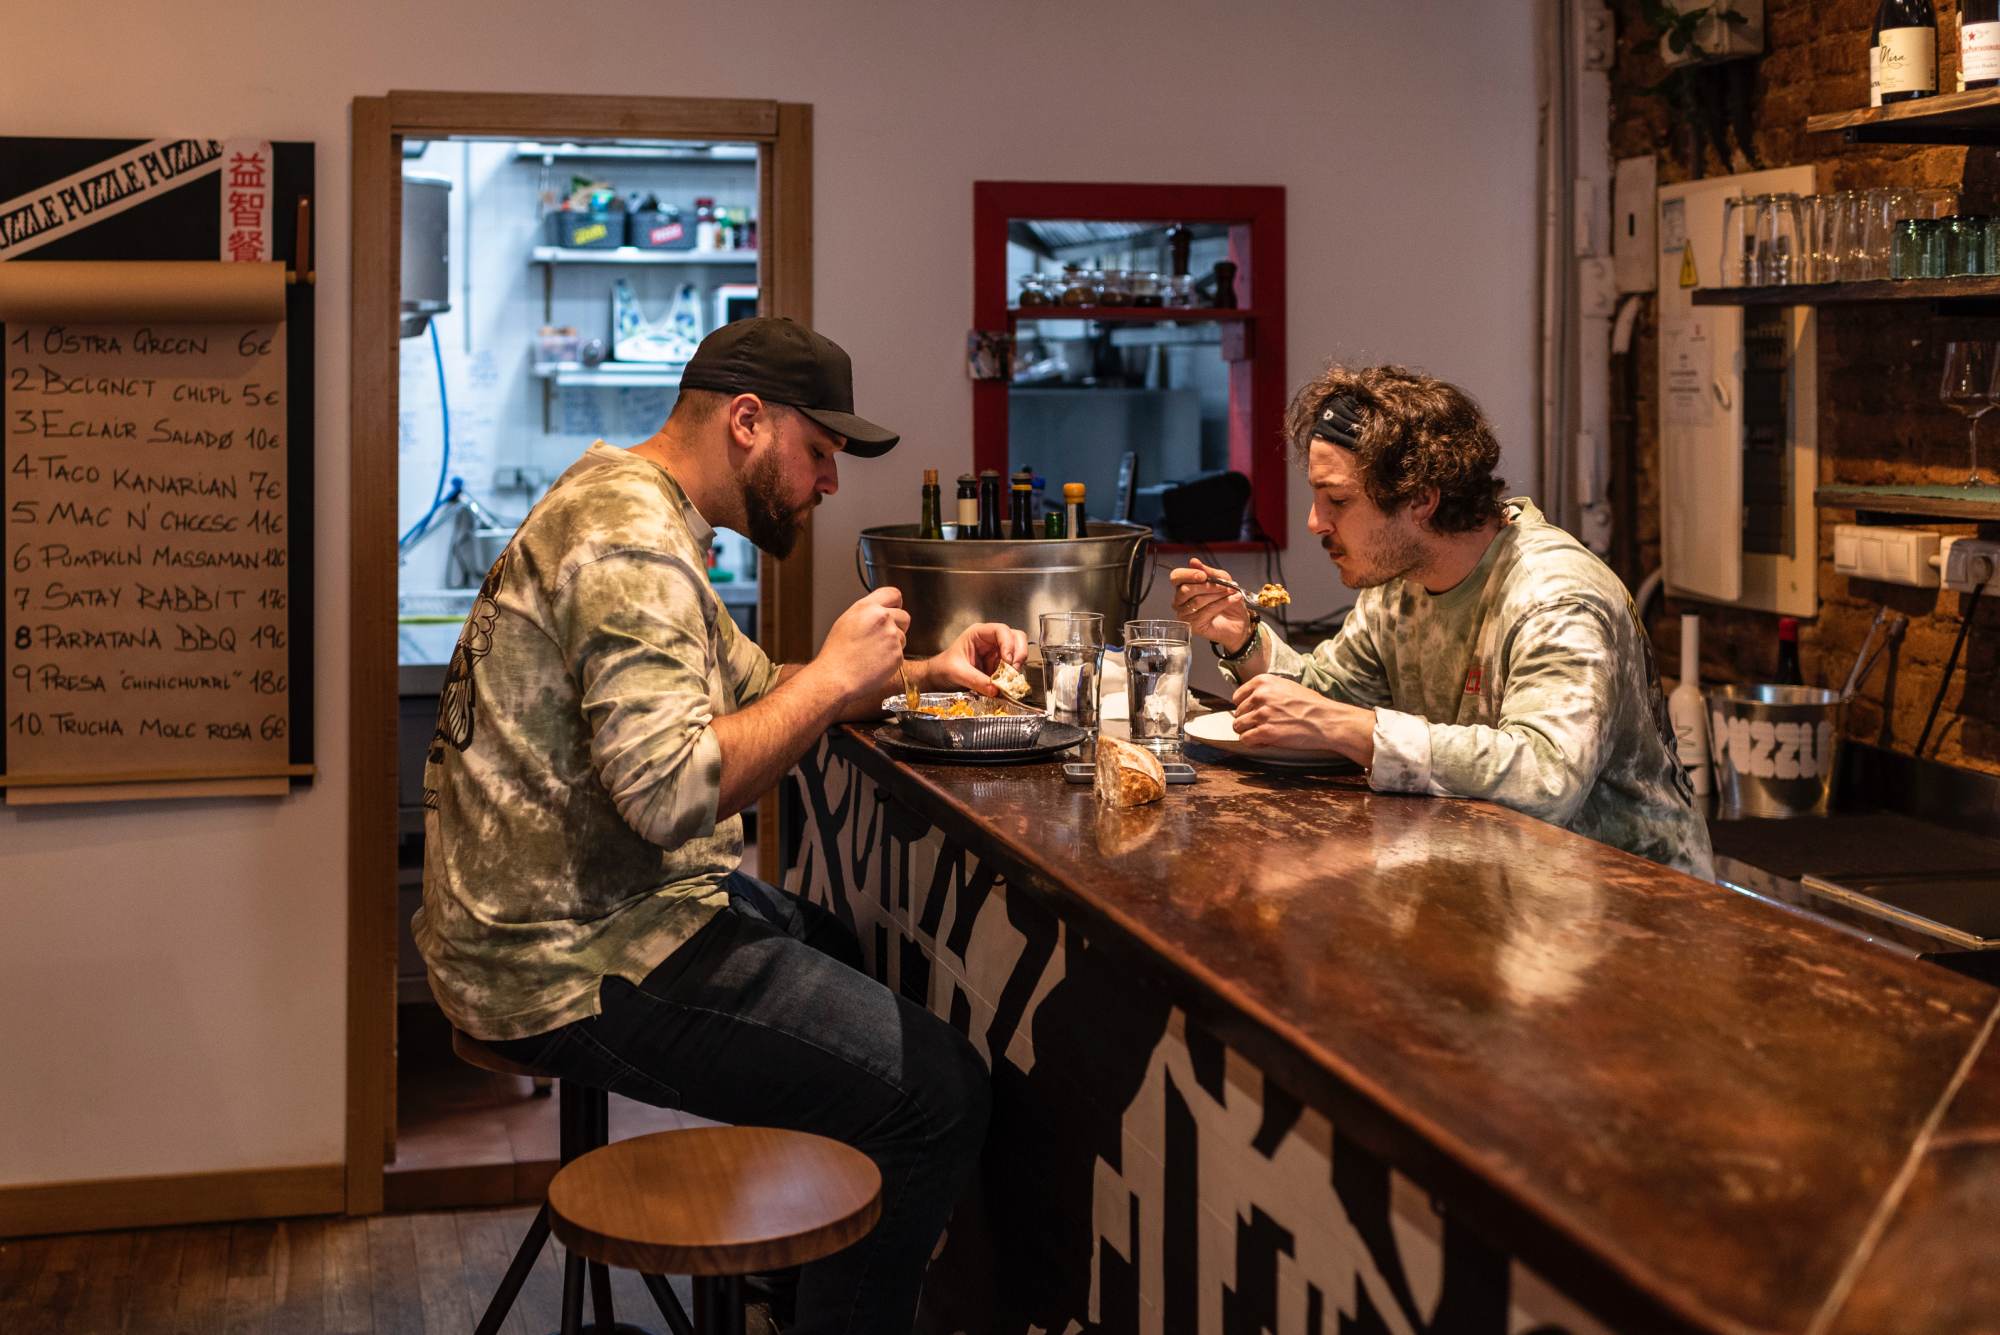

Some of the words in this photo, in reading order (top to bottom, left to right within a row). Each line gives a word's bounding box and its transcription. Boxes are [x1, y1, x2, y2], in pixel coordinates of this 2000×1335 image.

[57, 161, 146, 221] PUZZLE
[238, 329, 272, 357] 6€
[11, 367, 36, 391] 2
[242, 384, 280, 406] 5€
[12, 410, 37, 435] 3
[244, 427, 280, 451] 10€
[38, 454, 100, 483] TACO
[249, 471, 281, 500] 7€
[47, 501, 112, 528] MAC
[246, 509, 283, 535] 11€
[13, 542, 31, 573] 6
[152, 546, 259, 570] MASSAMAN
[14, 587, 30, 611] 7
[40, 582, 122, 611] SATAY
[135, 582, 246, 613] RABBIT
[14, 624, 32, 649] 8
[35, 624, 162, 650] PARPATANA
[173, 623, 236, 653] BBQ
[12, 663, 31, 692] 9
[36, 663, 106, 693] PRESA
[49, 711, 124, 736] TRUCHA
[206, 722, 252, 740] ROSA
